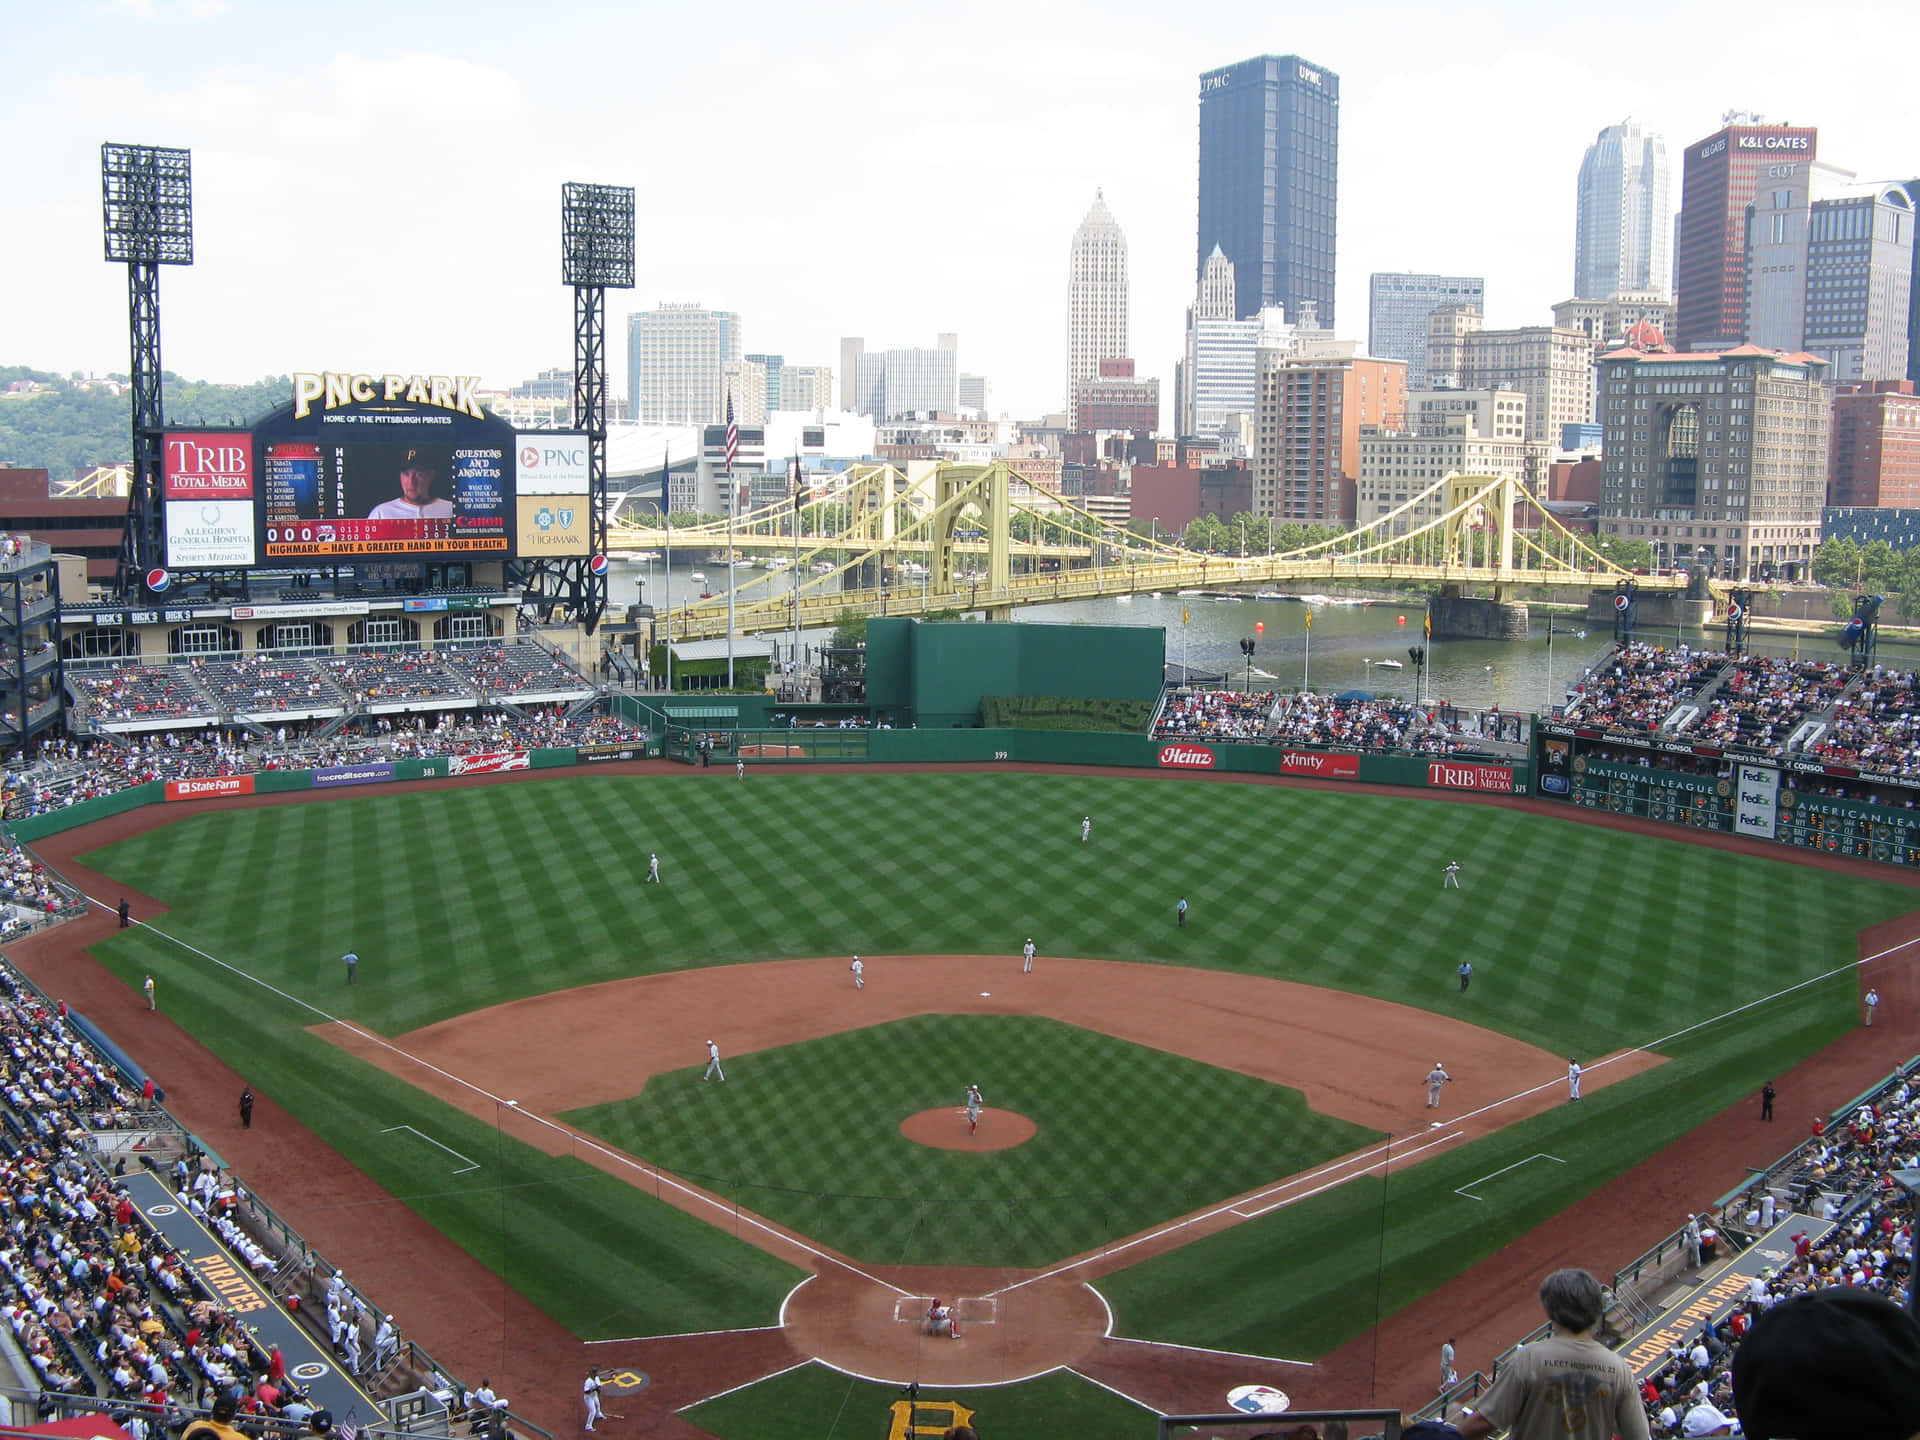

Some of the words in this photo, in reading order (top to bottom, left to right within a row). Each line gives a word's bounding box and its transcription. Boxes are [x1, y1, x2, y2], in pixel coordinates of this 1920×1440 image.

[1299, 65, 1322, 86] UPMC
[1200, 73, 1231, 93] UPMC
[1739, 136, 1763, 149] K&L
[1765, 136, 1808, 149] GATES
[1768, 163, 1797, 178] EQT
[293, 372, 377, 420] PNC
[384, 375, 485, 420] PARK
[323, 415, 346, 423] HOME
[359, 416, 373, 424] THE
[375, 416, 421, 424] PITTSBURGH
[422, 416, 452, 424] PIRATES
[169, 441, 247, 473] TRIB
[456, 449, 502, 459] QUESTIONS
[544, 449, 585, 466] PNC
[468, 459, 490, 468] AND
[458, 468, 501, 478] ANSWERS
[170, 475, 209, 488] TOTAL
[211, 476, 247, 488] MEDIA
[336, 448, 344, 516] Hanrahan
[456, 515, 504, 528] Canon
[184, 527, 236, 536] ALLEGHENY
[268, 528, 278, 542] 0
[284, 528, 294, 541] 0
[302, 528, 312, 541] 0
[169, 536, 210, 545] GENERAL
[211, 535, 251, 544] HOSPITAL
[270, 544, 320, 554] HIGHMARK
[332, 544, 354, 552] HAVE
[358, 543, 364, 552] A
[366, 542, 404, 552] GREATER
[408, 541, 432, 550] HAND
[434, 541, 444, 550] IN
[448, 540, 470, 550] YOUR
[532, 535, 580, 545] HIGHMARK
[207, 553, 248, 561] MEDICINE
[96, 612, 123, 625] DICK'S
[132, 612, 159, 623] DICK'S
[165, 610, 191, 622] DICK'S
[994, 751, 1008, 760] 399
[1161, 748, 1212, 765] Heinz
[1551, 726, 1576, 736] CONSOL
[1665, 743, 1693, 753] CONSOL
[1794, 762, 1825, 773] CONSOL
[456, 752, 516, 775] Budweiser
[1282, 752, 1324, 770] xfinity
[317, 770, 390, 783] freecreditscore.com
[1429, 764, 1474, 787] TRIB
[1479, 768, 1511, 780] TOTAL
[1588, 767, 1656, 785] NATIONAL
[1661, 778, 1713, 795] LEAGUE
[1743, 770, 1771, 783] FedEx
[1480, 778, 1511, 790] MEDIA
[1514, 784, 1526, 793] 375
[1742, 792, 1770, 806] FedEx
[1798, 802, 1880, 823] AMERICAN
[1740, 813, 1768, 828] FedEx
[192, 1254, 268, 1313] PIRATES
[1707, 1272, 1756, 1300] PARK
[1681, 1296, 1724, 1321] PNC
[1670, 1318, 1696, 1330] TO
[1622, 1328, 1684, 1375] LCOME
